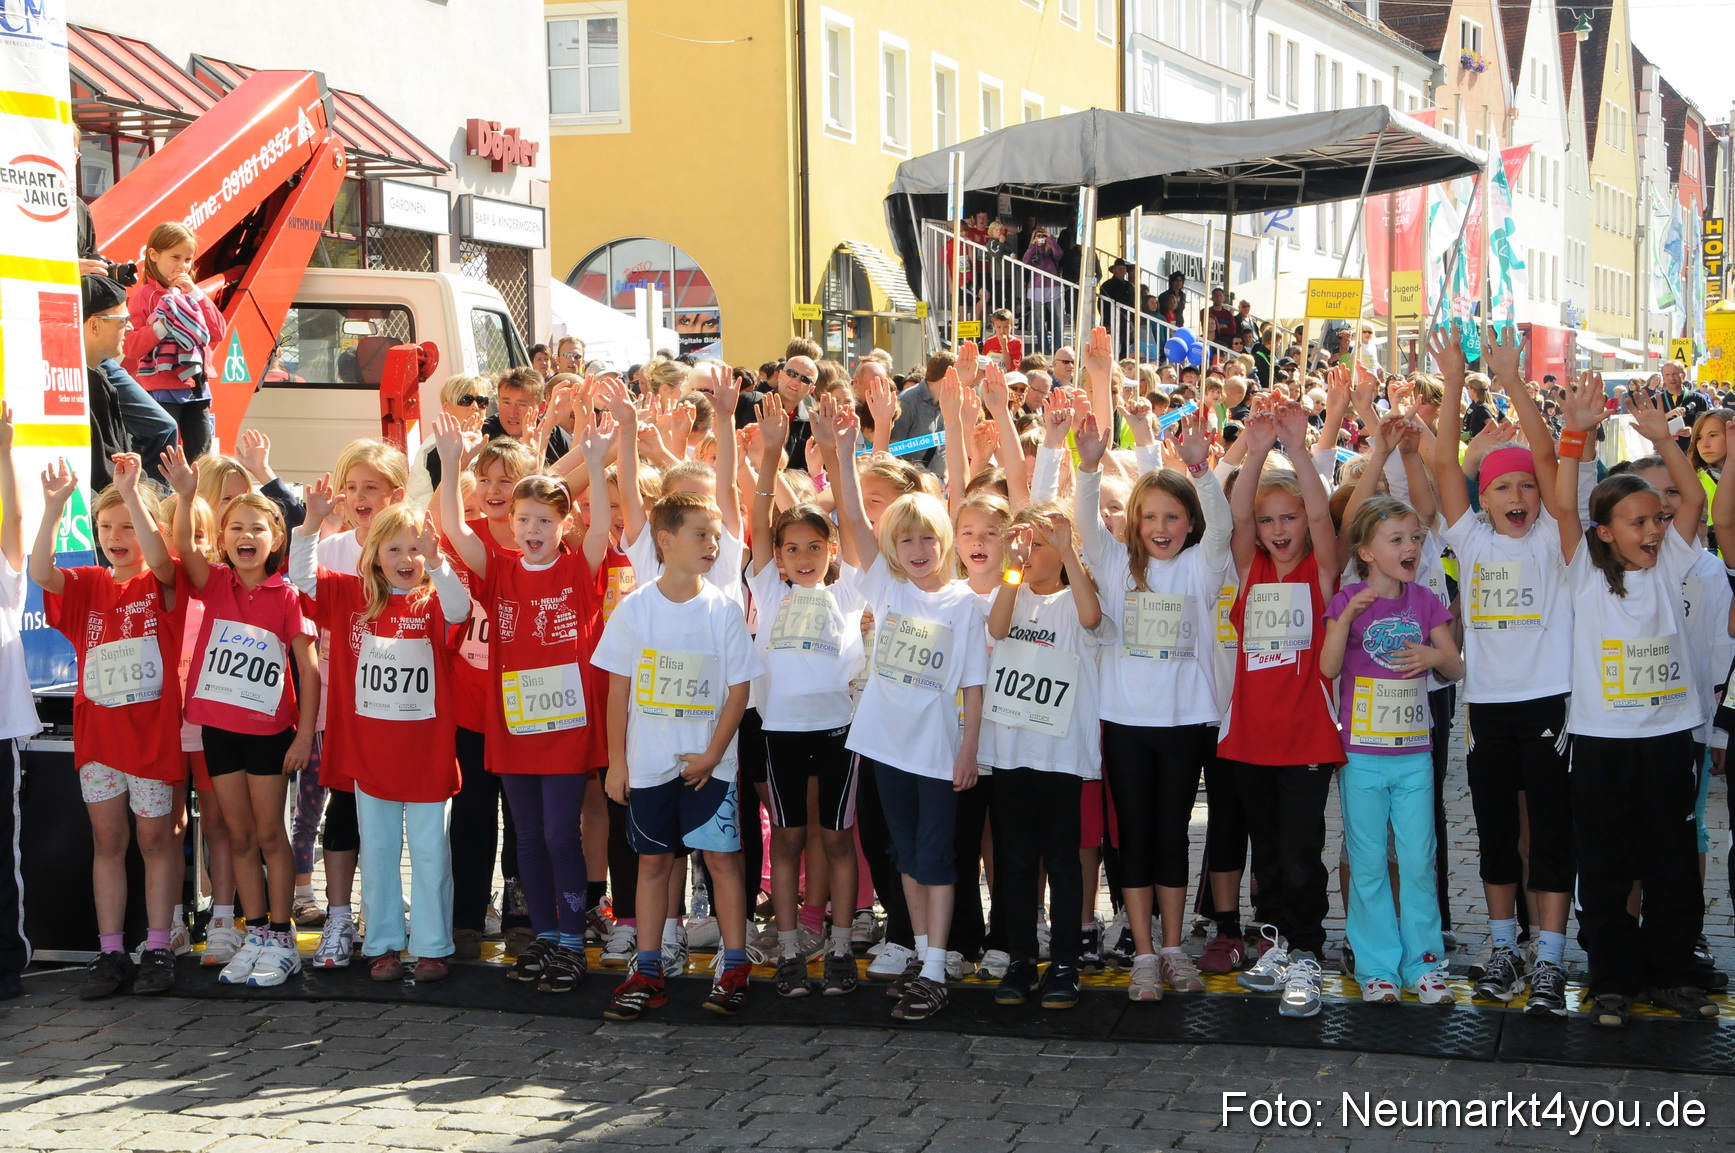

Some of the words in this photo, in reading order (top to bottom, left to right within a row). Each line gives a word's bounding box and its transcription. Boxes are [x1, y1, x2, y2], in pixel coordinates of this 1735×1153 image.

[259, 126, 293, 171] 6352
[467, 119, 540, 174] Döpfer
[389, 197, 427, 215] GARDINEN
[288, 216, 323, 233] RUTHMANN
[475, 212, 490, 224] BABY
[491, 215, 496, 226] &
[498, 216, 542, 234] KINDERMODEN
[624, 261, 652, 281] FOTO
[1310, 289, 1359, 300] Schnupper-
[1393, 284, 1421, 294] Jugend-
[1325, 300, 1342, 309] lauf
[1400, 294, 1414, 302] lauf
[1675, 347, 1686, 362] A
[42, 360, 83, 392] Braun
[1480, 567, 1509, 581] Sarah
[606, 590, 614, 600] K3
[1253, 589, 1280, 602] Laura
[1481, 588, 1534, 608] 7125
[1143, 597, 1182, 612] Luciana
[791, 611, 825, 631] 719
[1125, 615, 1135, 626] K3
[1220, 609, 1230, 620] K3
[1254, 608, 1305, 629] 7040
[900, 620, 929, 640] Sarah
[1143, 619, 1192, 640] 7049
[219, 626, 268, 651] Lena
[880, 634, 890, 646] K3
[1280, 639, 1310, 647] PFLEIDERER
[1362, 624, 1422, 654] Fever
[101, 646, 135, 661] Sophie
[894, 640, 944, 670] 7190
[1259, 652, 1282, 664] DEHN
[1626, 644, 1670, 658] Marlene
[208, 647, 281, 688] 10206
[659, 655, 684, 671] Elisa
[86, 671, 96, 681] K3
[104, 661, 157, 686] 7183
[361, 663, 429, 694] 10370
[639, 672, 650, 684] K3
[1606, 666, 1617, 676] K3
[1629, 661, 1680, 686] 7192
[521, 675, 544, 688] Sina
[659, 676, 711, 698] 7154
[912, 677, 944, 689] PFLEIDERER
[995, 666, 1070, 708] 10207
[1376, 684, 1418, 698] Susanna
[1659, 691, 1687, 702] PFLEIDERER
[506, 695, 517, 706] K3
[525, 689, 578, 713] 7008
[1356, 702, 1367, 713] K3
[684, 708, 715, 717] PFLEIDERER
[1377, 704, 1424, 724] 7198
[556, 716, 586, 726] PFLEIDERER
[1403, 734, 1428, 743] PFLEIDERER
